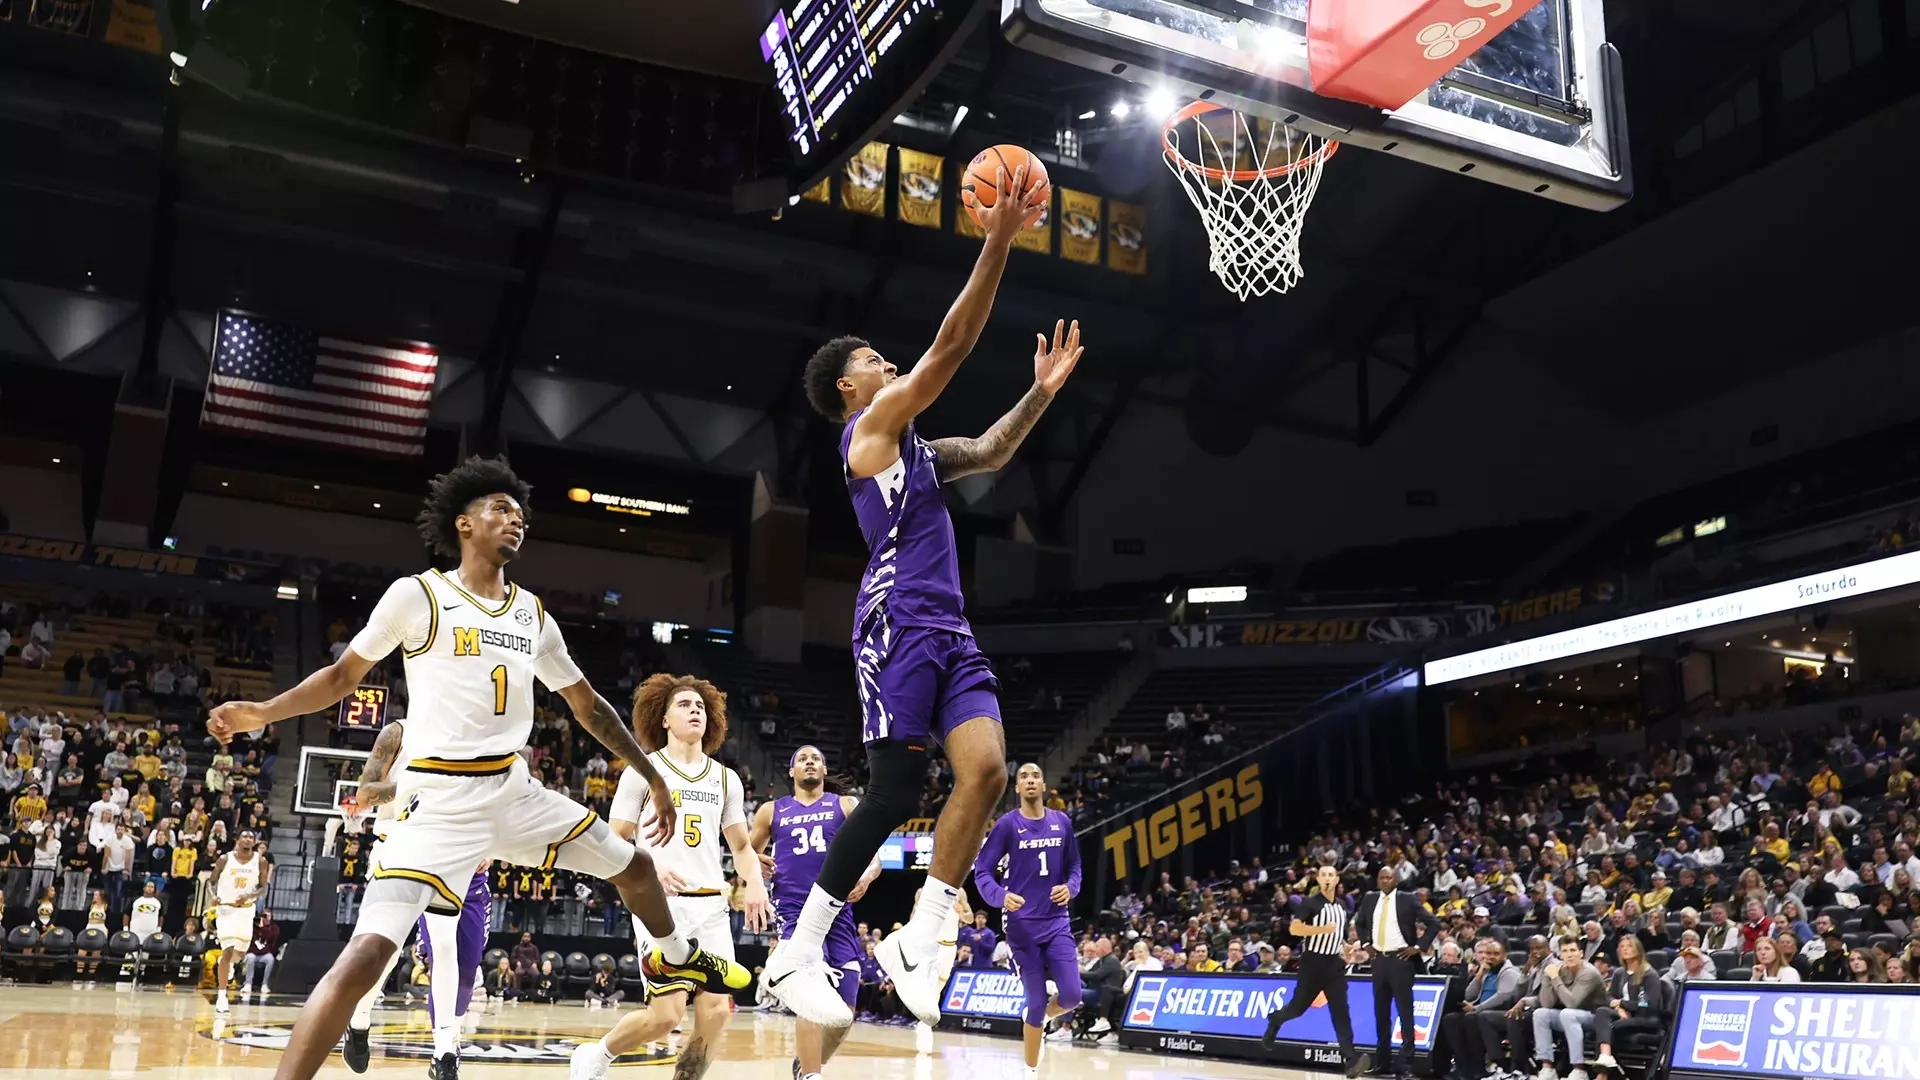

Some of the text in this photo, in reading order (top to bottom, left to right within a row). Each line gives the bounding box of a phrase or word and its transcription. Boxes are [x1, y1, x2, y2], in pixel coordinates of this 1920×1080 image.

[620, 497, 665, 512] SOUTHERN
[666, 503, 690, 515] BANK
[1500, 588, 1582, 626] TIGERS
[1695, 602, 1744, 620] Rivalry
[1797, 574, 1858, 598] Saturda
[453, 627, 532, 656] MISSOURI
[1242, 620, 1363, 645] MIZZOU
[354, 689, 384, 703] 4:57
[491, 664, 508, 716] 1
[347, 701, 378, 725] 27
[684, 814, 701, 848] 5
[779, 811, 835, 827] K-STATE
[1104, 763, 1263, 881] TIGERS
[791, 825, 827, 855] 34
[1018, 837, 1062, 850] K-STATE
[1038, 851, 1049, 876] 1
[1162, 987, 1244, 1018] SHELTER
[1703, 1012, 1746, 1024] SHELTER
[1167, 1037, 1205, 1052] Health Care
[1314, 1049, 1342, 1064] Health
